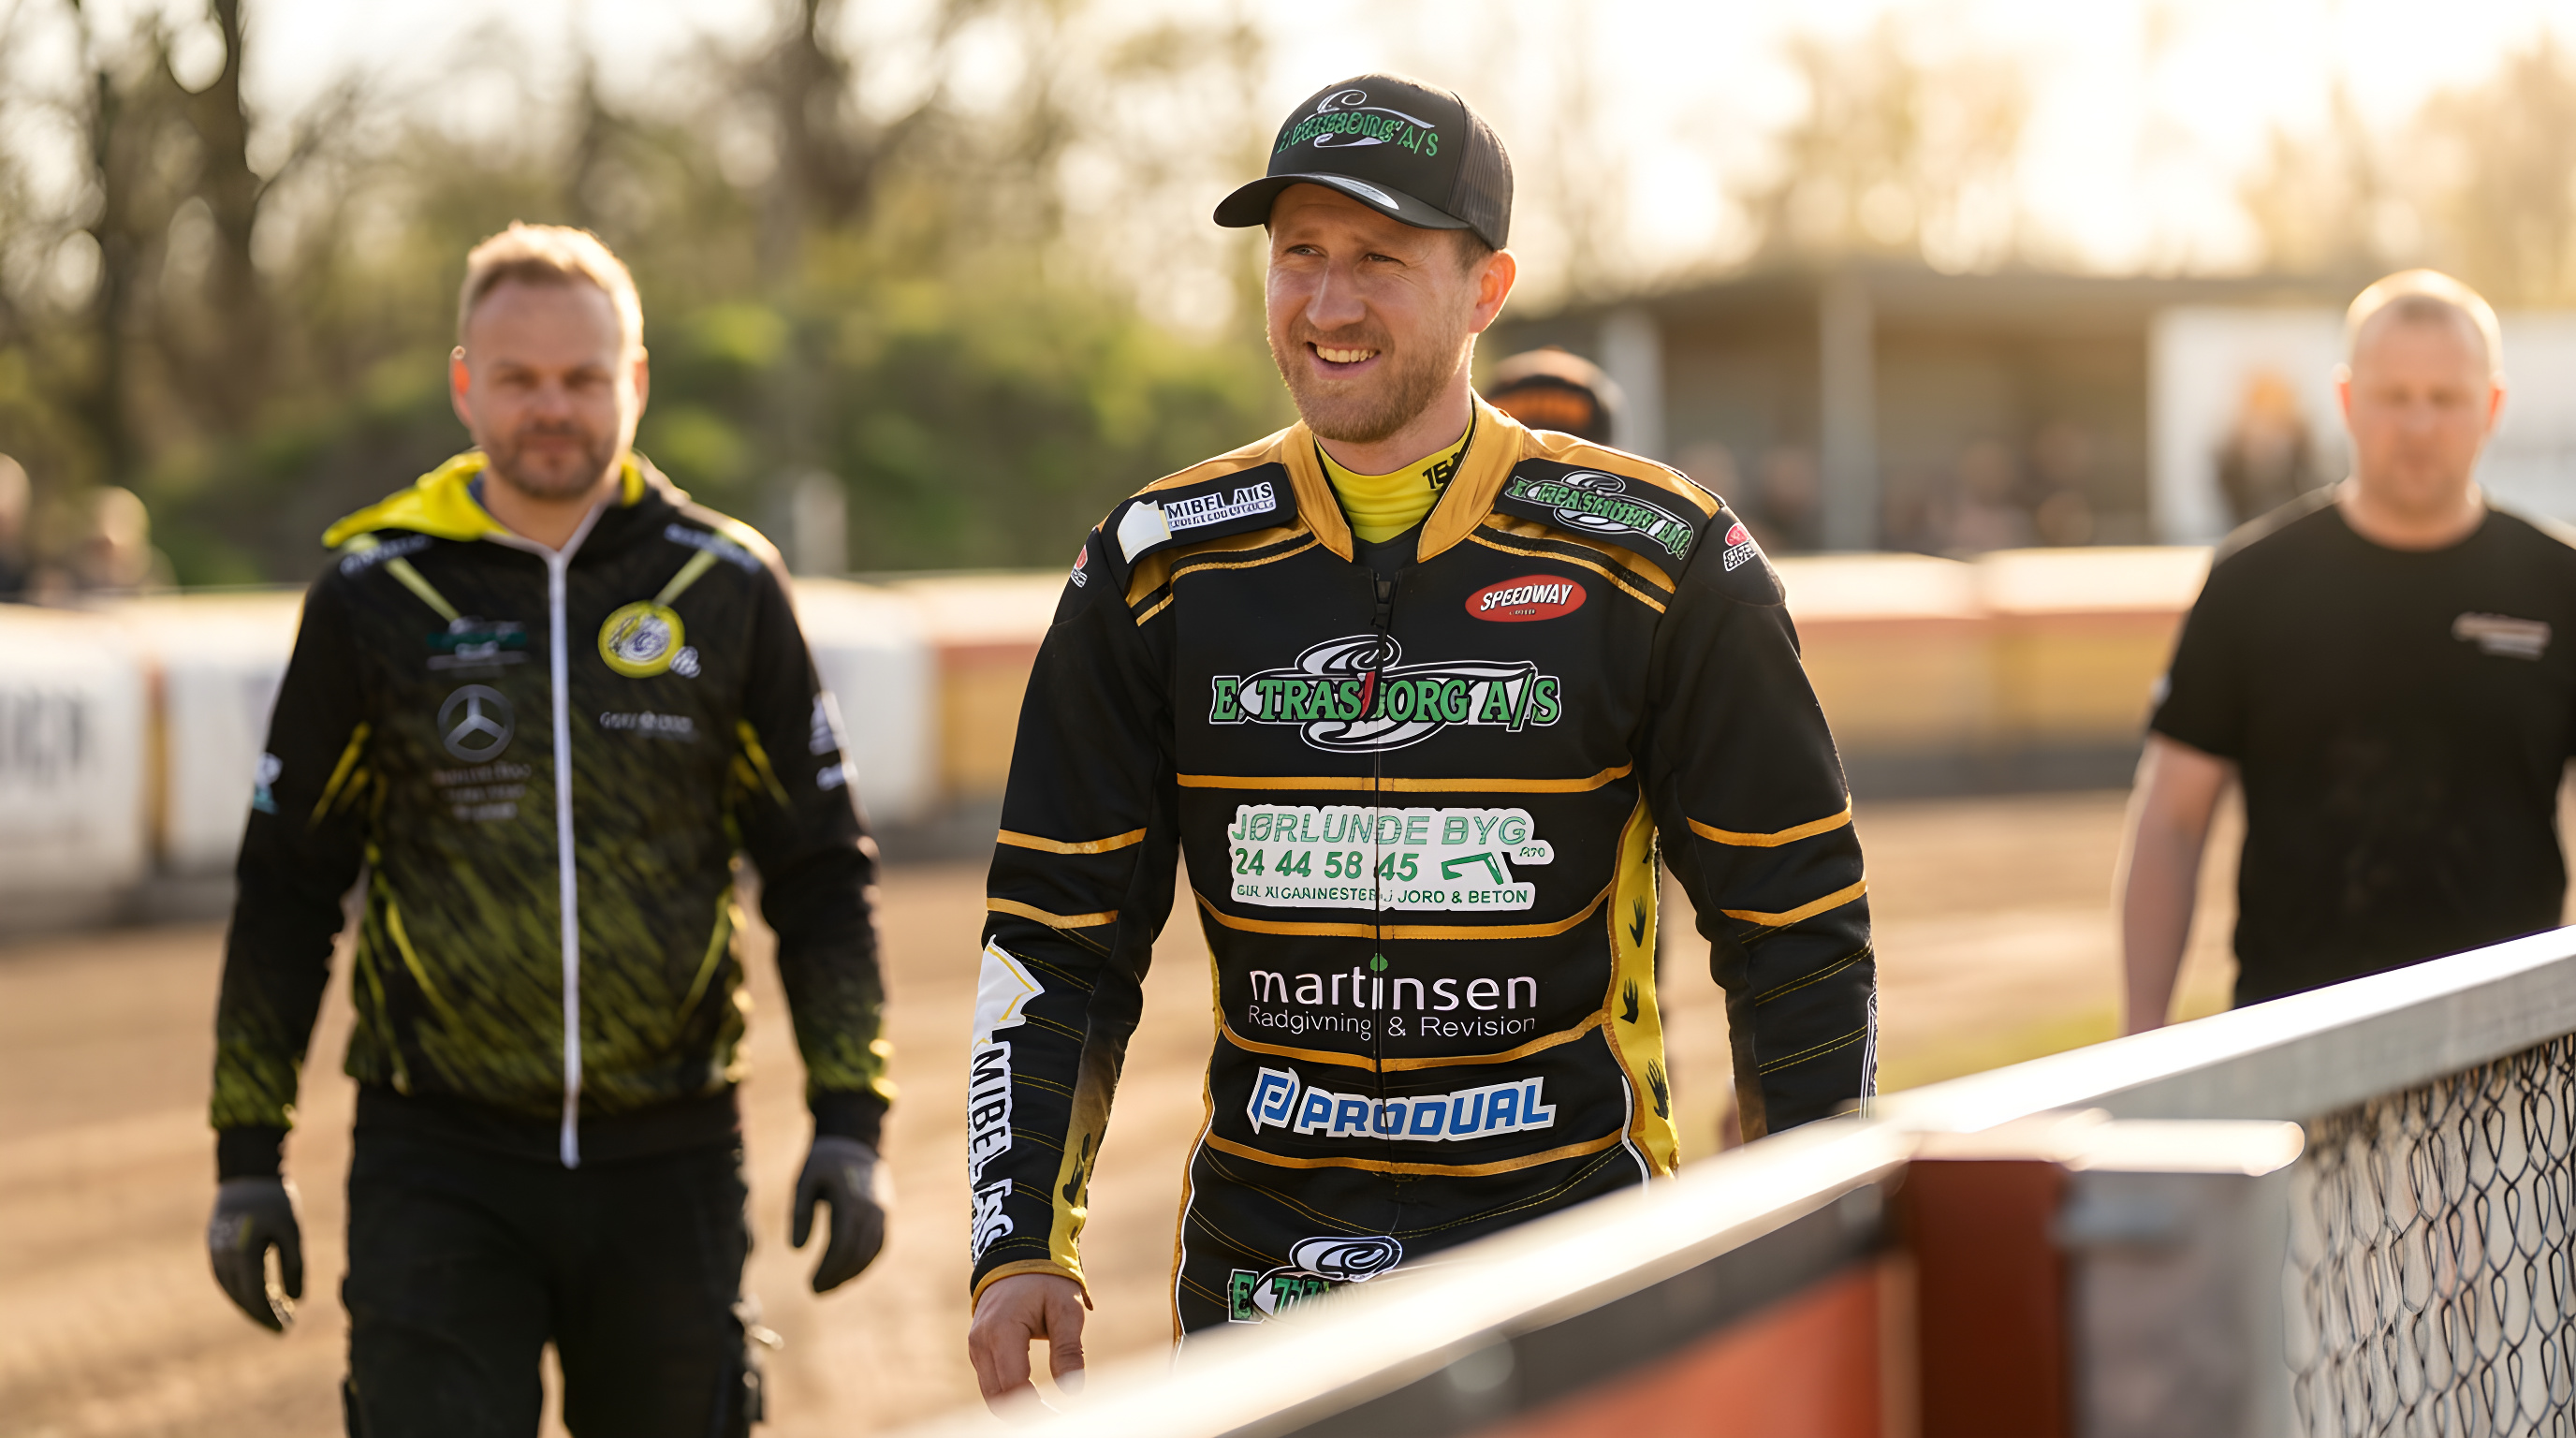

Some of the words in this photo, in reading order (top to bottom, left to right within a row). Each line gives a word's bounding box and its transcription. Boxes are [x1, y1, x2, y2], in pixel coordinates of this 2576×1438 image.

[1165, 493, 1223, 520] MIBEL
[1480, 583, 1573, 611] SPEEDWAY
[1479, 671, 1560, 729] A/S
[1231, 813, 1430, 845] JØRLUNDE
[1441, 815, 1527, 845] BYG
[1236, 847, 1265, 876] 24
[1274, 849, 1311, 877] 44
[1324, 851, 1363, 879] 58
[1377, 853, 1419, 882] 45
[1451, 890, 1462, 903] &
[1468, 889, 1528, 903] BETON
[1250, 954, 1538, 1011] martinsen
[1248, 1005, 1372, 1041] Radgivning
[1387, 1016, 1407, 1037] &
[1420, 1016, 1535, 1037] Revision
[972, 1047, 1008, 1179] MIBEL
[1299, 1084, 1550, 1136] PRODUAL
